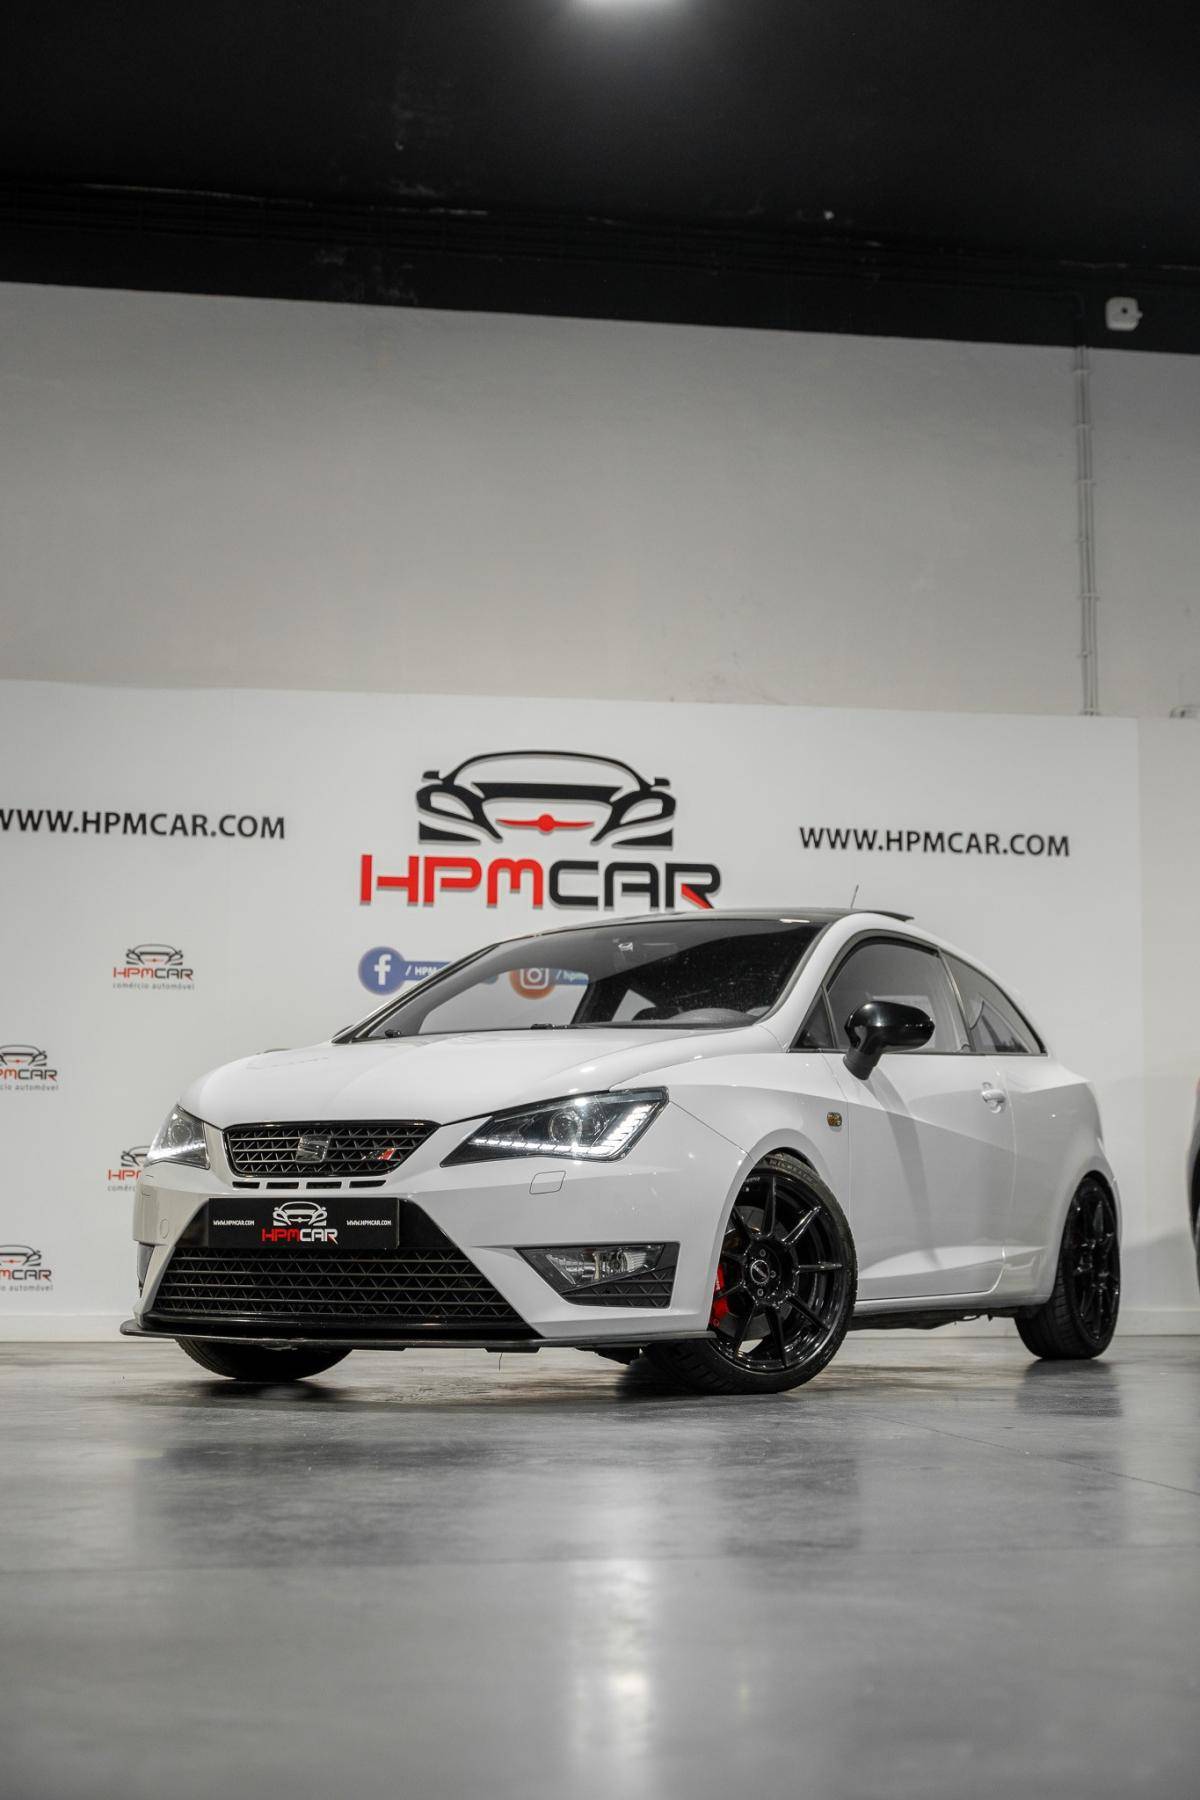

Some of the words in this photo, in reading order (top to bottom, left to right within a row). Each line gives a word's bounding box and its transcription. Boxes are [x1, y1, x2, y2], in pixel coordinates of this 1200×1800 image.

[799, 826, 1070, 857] WWW.HPMCAR.COM
[360, 854, 721, 911] HPMCAR
[113, 967, 193, 980] HPMCAR
[0, 1068, 58, 1082] MCAR
[261, 1228, 339, 1245] HPMCAR
[0, 1268, 52, 1281] MCAR
